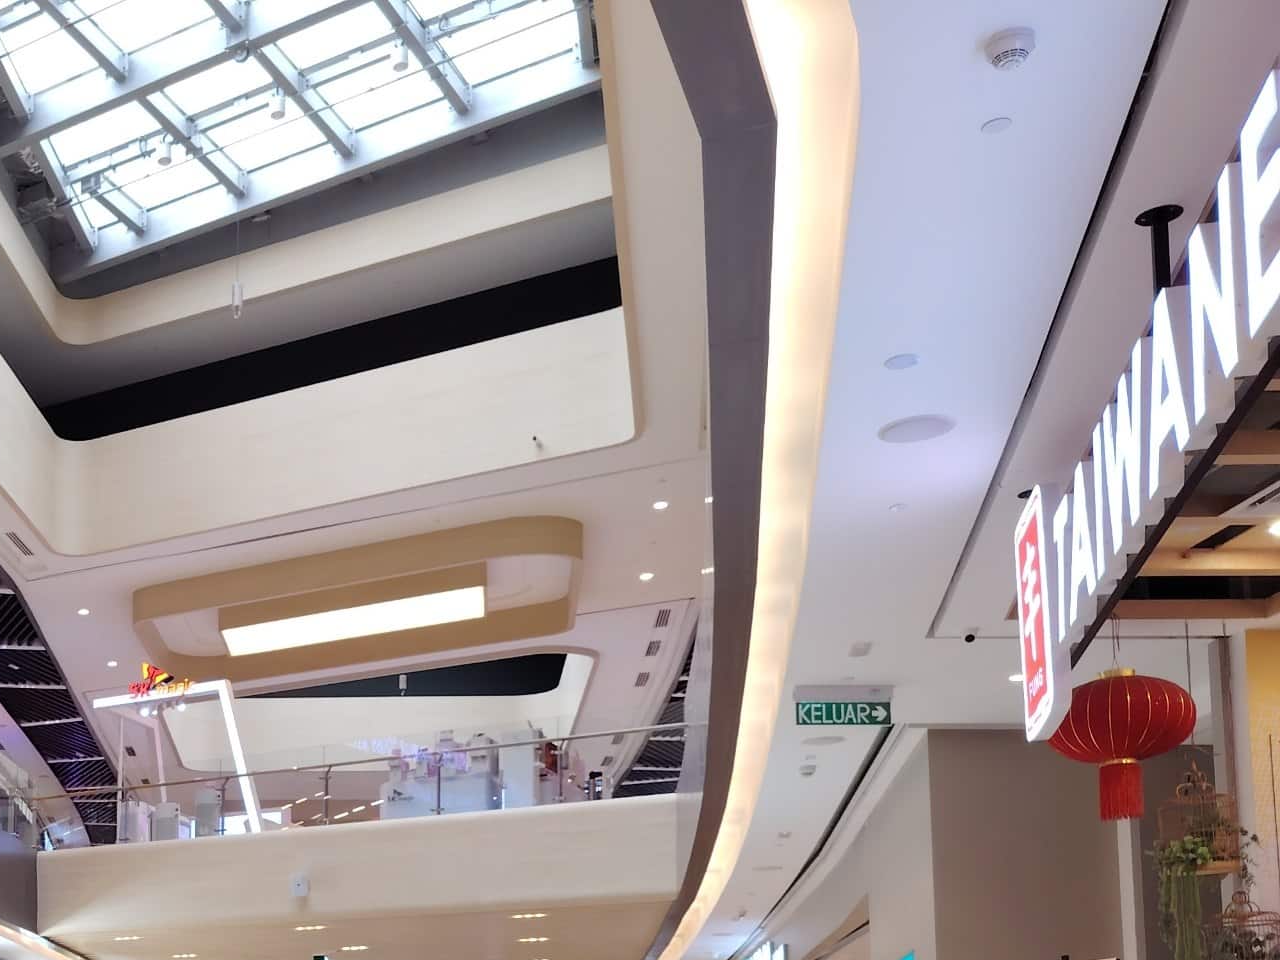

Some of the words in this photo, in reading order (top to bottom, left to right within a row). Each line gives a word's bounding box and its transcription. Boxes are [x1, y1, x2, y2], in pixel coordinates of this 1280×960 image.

[1053, 68, 1280, 645] TAIWANE
[1028, 667, 1044, 702] FUNG
[798, 703, 870, 724] KELUAR
